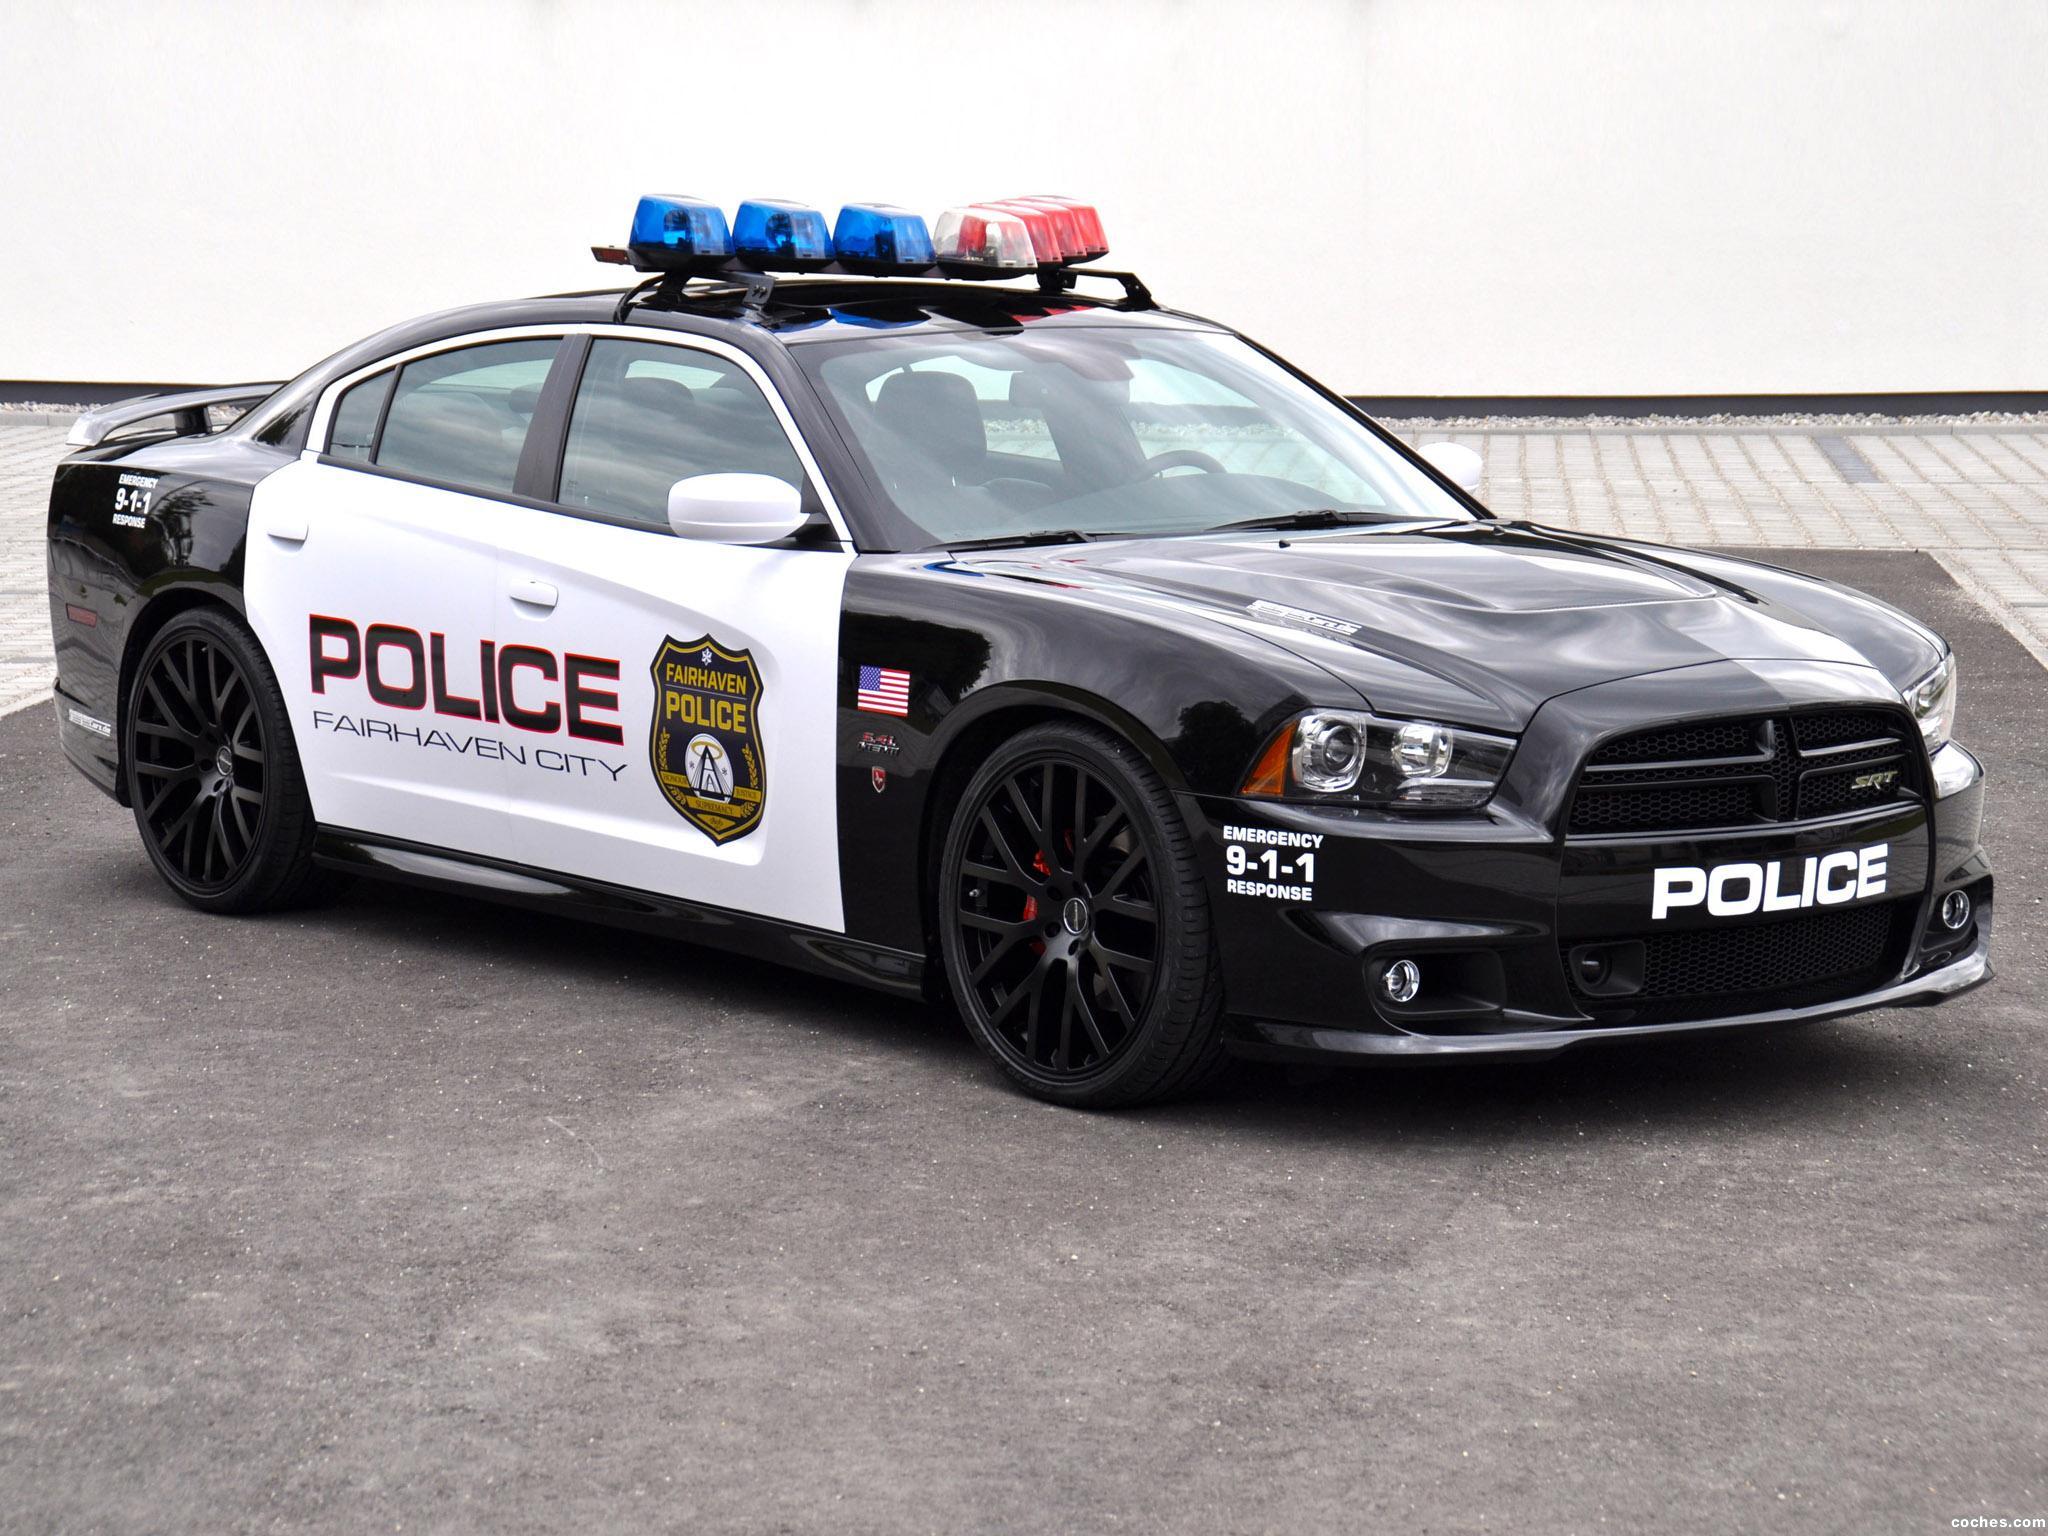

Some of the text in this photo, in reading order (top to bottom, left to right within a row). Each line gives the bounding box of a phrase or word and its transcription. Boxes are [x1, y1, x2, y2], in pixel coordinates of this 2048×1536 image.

[118, 473, 159, 488] EMERGENCY
[115, 488, 152, 514] 9-1-1
[112, 513, 146, 528] RESPONSE
[309, 613, 625, 746] POLICE
[666, 663, 747, 695] FAIRHAVEN
[666, 690, 747, 734] POLICE
[313, 710, 628, 782] FAIRHAVEN CITY
[1851, 771, 1898, 790] SRT
[1223, 825, 1324, 849] EMERGENCY
[1226, 845, 1315, 883] 9-1-1
[1227, 879, 1312, 901] RESPONSE
[1651, 843, 1888, 920] POLICE
